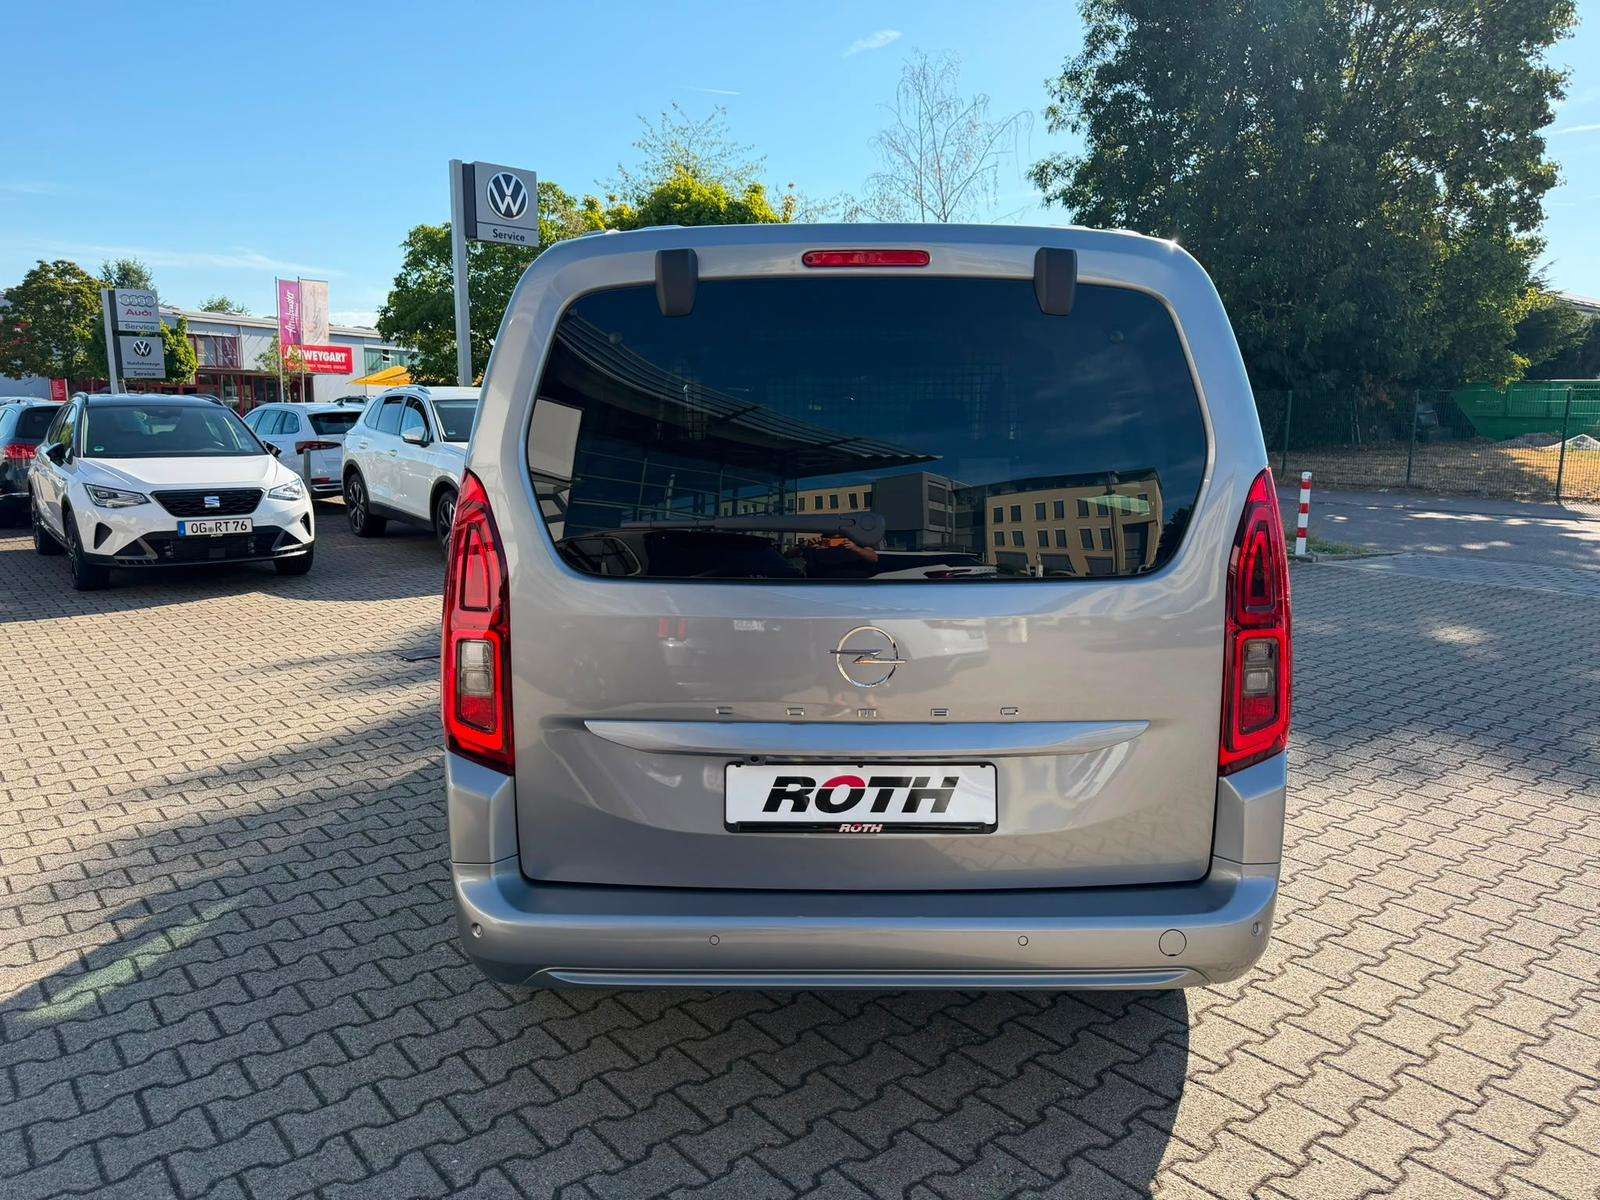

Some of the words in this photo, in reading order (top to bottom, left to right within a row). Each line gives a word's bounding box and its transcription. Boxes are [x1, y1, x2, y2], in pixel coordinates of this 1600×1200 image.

[492, 228, 526, 242] Service
[126, 308, 152, 317] Audi
[124, 323, 155, 331] Service
[302, 350, 346, 363] WEYGART
[191, 522, 207, 534] OG
[215, 521, 231, 532] RT
[233, 520, 248, 531] 76
[762, 774, 960, 814] ROTH
[839, 822, 883, 834] ROTH
